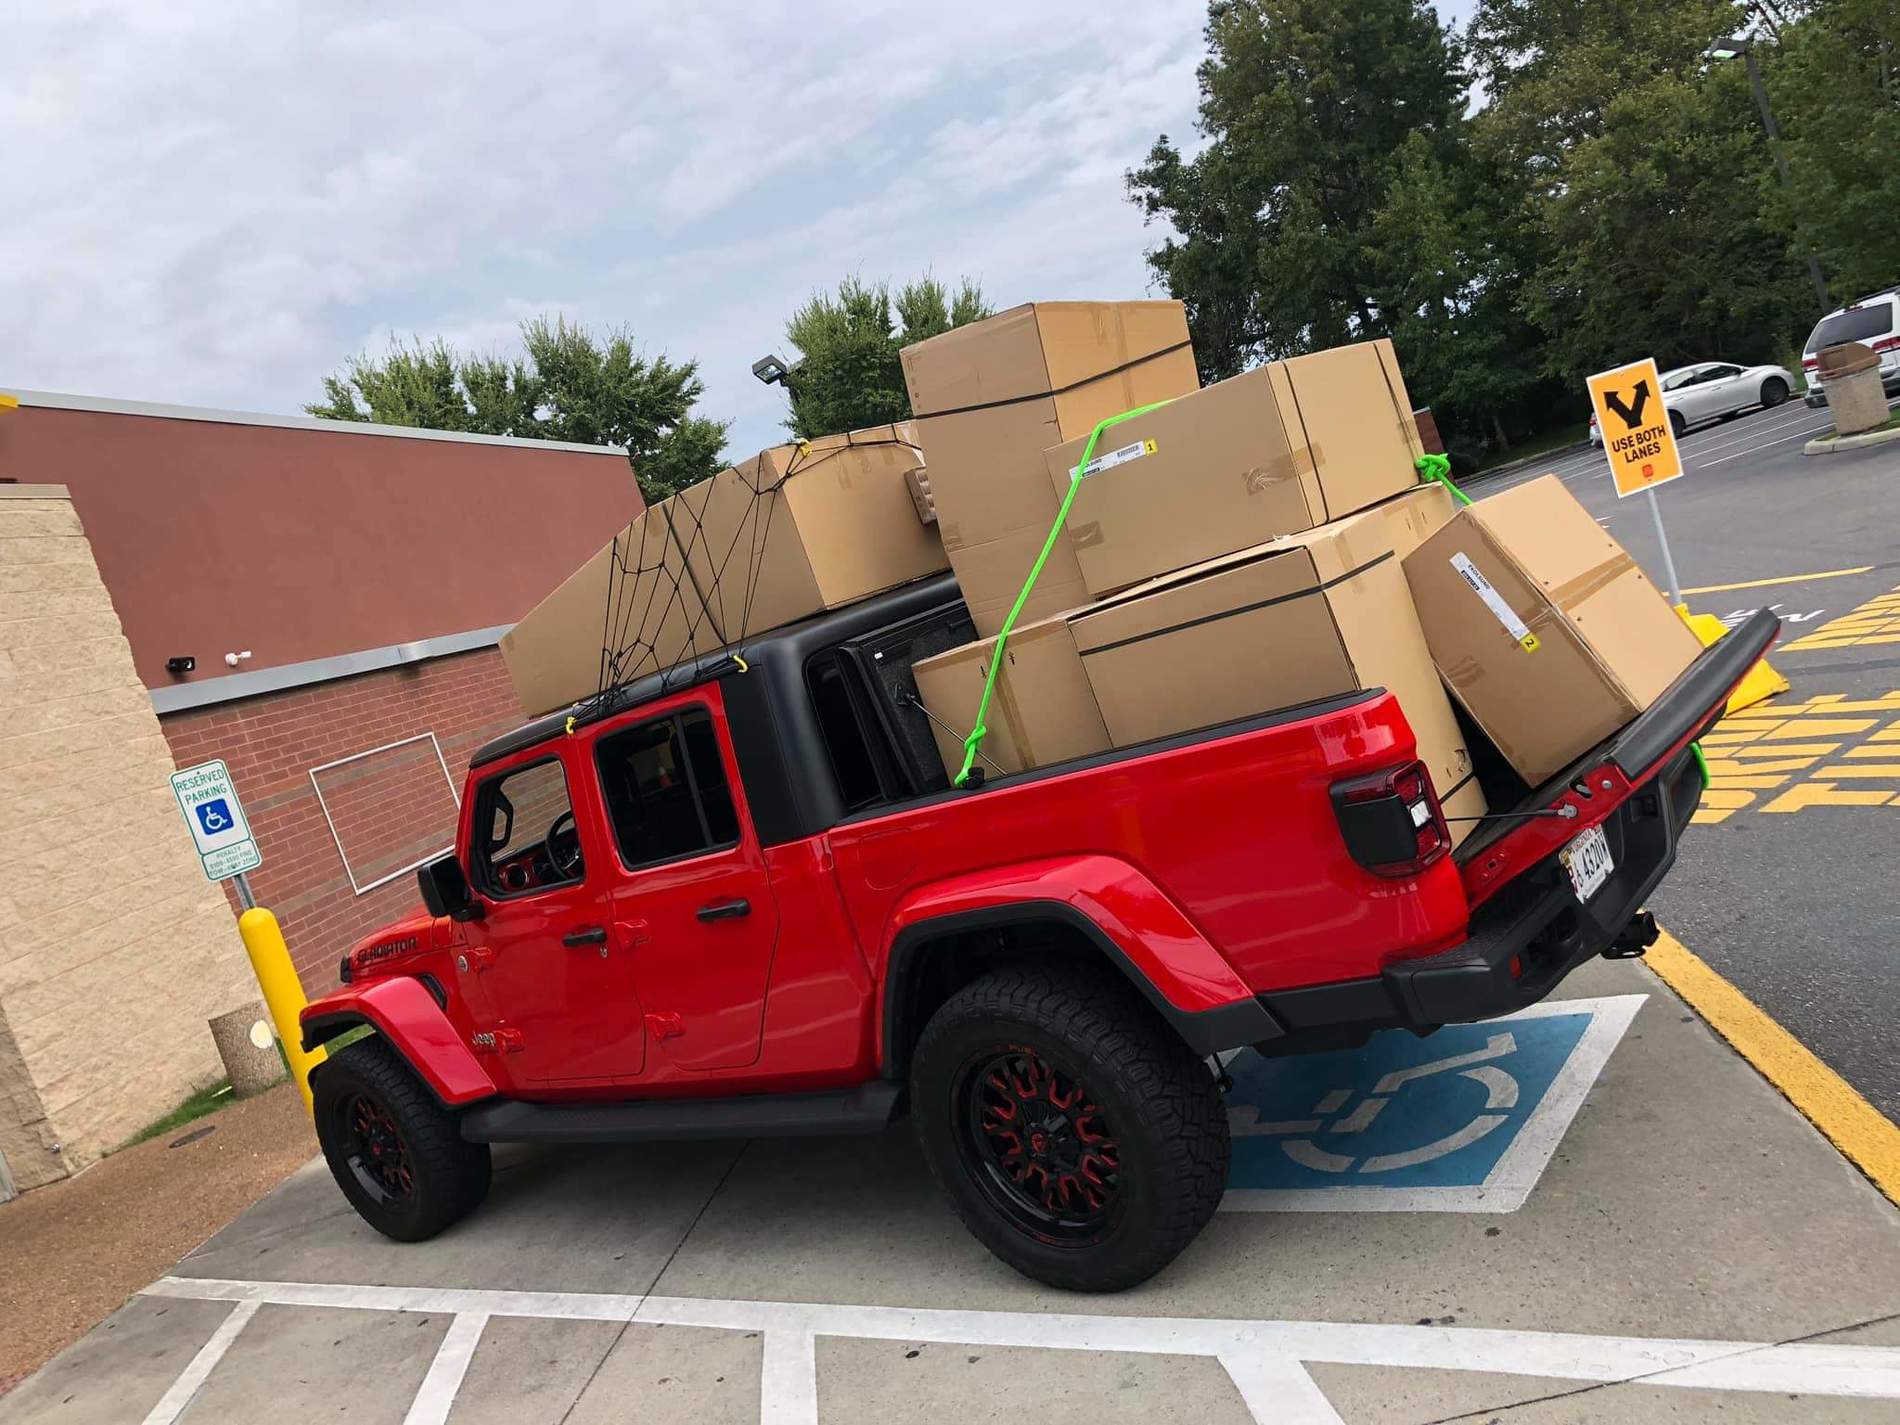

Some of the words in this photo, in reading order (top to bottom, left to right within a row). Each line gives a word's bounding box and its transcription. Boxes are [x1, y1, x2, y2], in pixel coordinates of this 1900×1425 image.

[1611, 435, 1634, 453] USE
[1635, 425, 1666, 445] BOTH
[1624, 441, 1661, 464] LANES
[1525, 638, 1535, 648] 2
[175, 768, 225, 793] RESERVED
[185, 783, 227, 805] PARKING
[356, 936, 418, 964] GLADIATOR
[472, 1031, 497, 1047] Jeep
